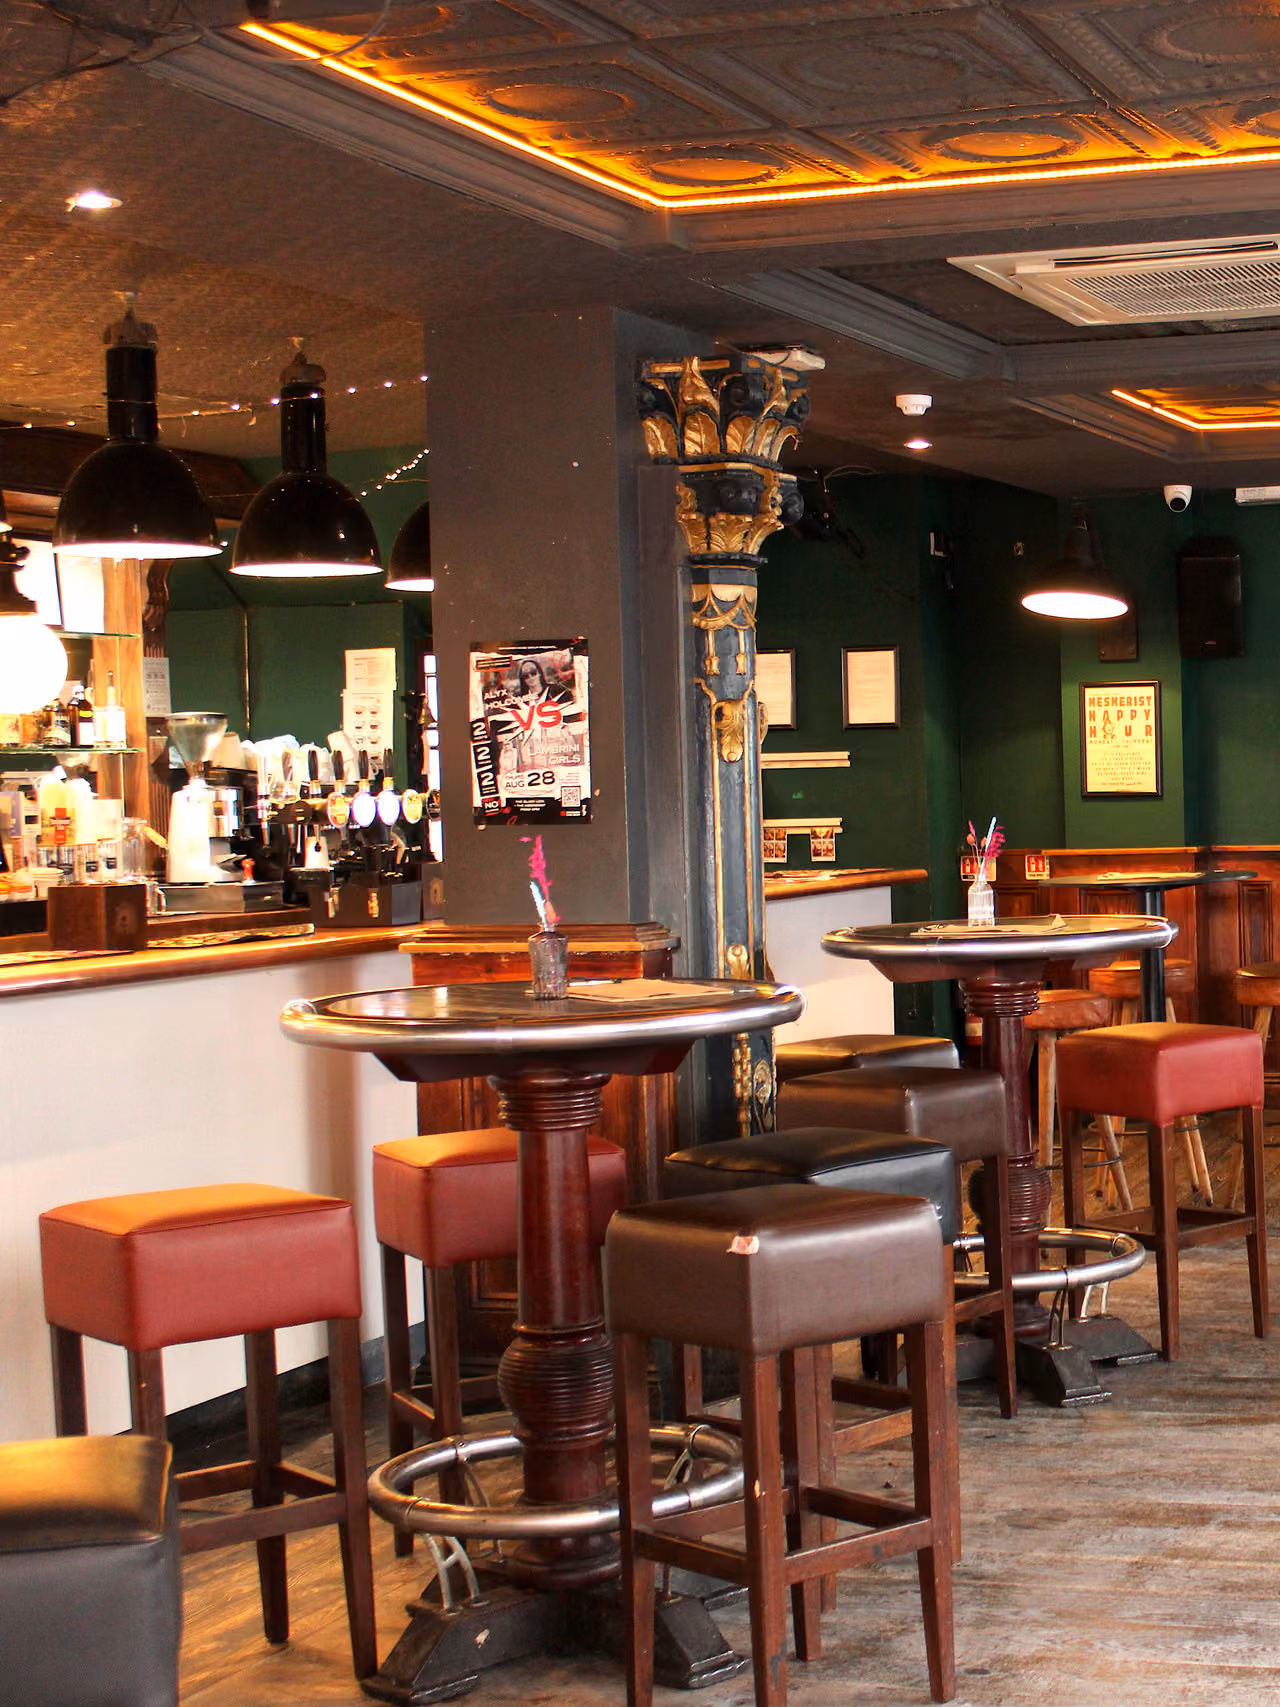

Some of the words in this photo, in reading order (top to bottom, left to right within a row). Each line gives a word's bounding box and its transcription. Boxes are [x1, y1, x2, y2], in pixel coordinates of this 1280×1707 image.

[484, 688, 508, 701] ALYX
[1088, 696, 1152, 708] MESMERIST
[511, 700, 563, 732] VS
[1088, 709, 1151, 722] HAPPY
[472, 722, 487, 736] 2
[476, 747, 491, 761] 2
[549, 754, 581, 765] GIRLS
[481, 772, 495, 786] 2
[505, 780, 525, 788] AUG
[527, 771, 555, 787] 28
